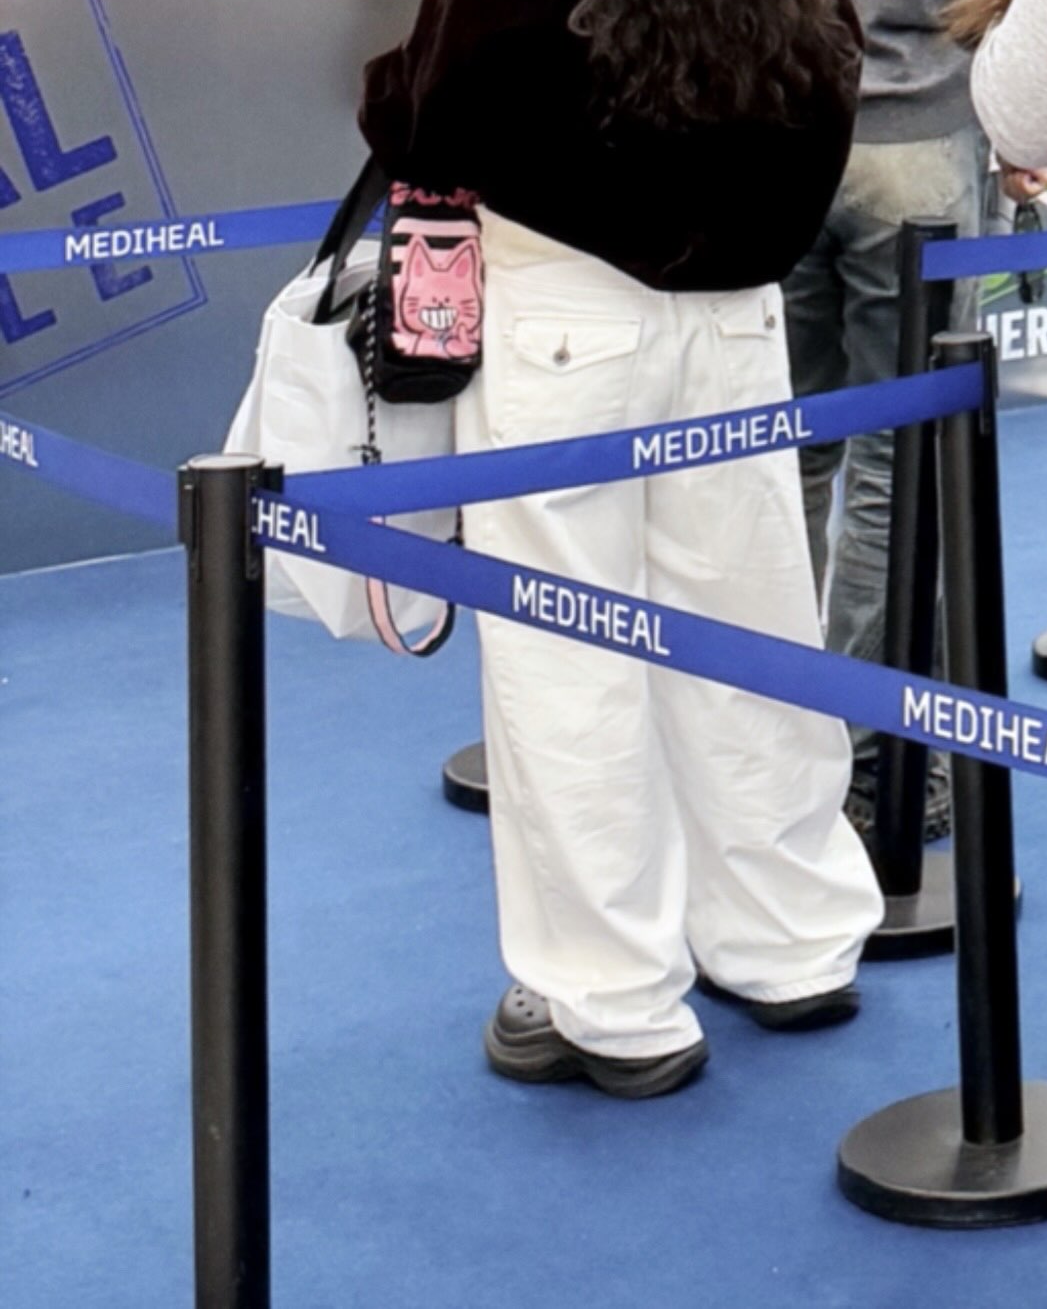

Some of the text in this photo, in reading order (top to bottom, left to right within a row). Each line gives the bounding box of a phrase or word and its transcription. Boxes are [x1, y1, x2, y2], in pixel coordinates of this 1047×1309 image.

[65, 221, 224, 262] MEDIHEAL
[632, 409, 813, 470] MEDIHEAL
[512, 575, 671, 657] MEDIHEAL
